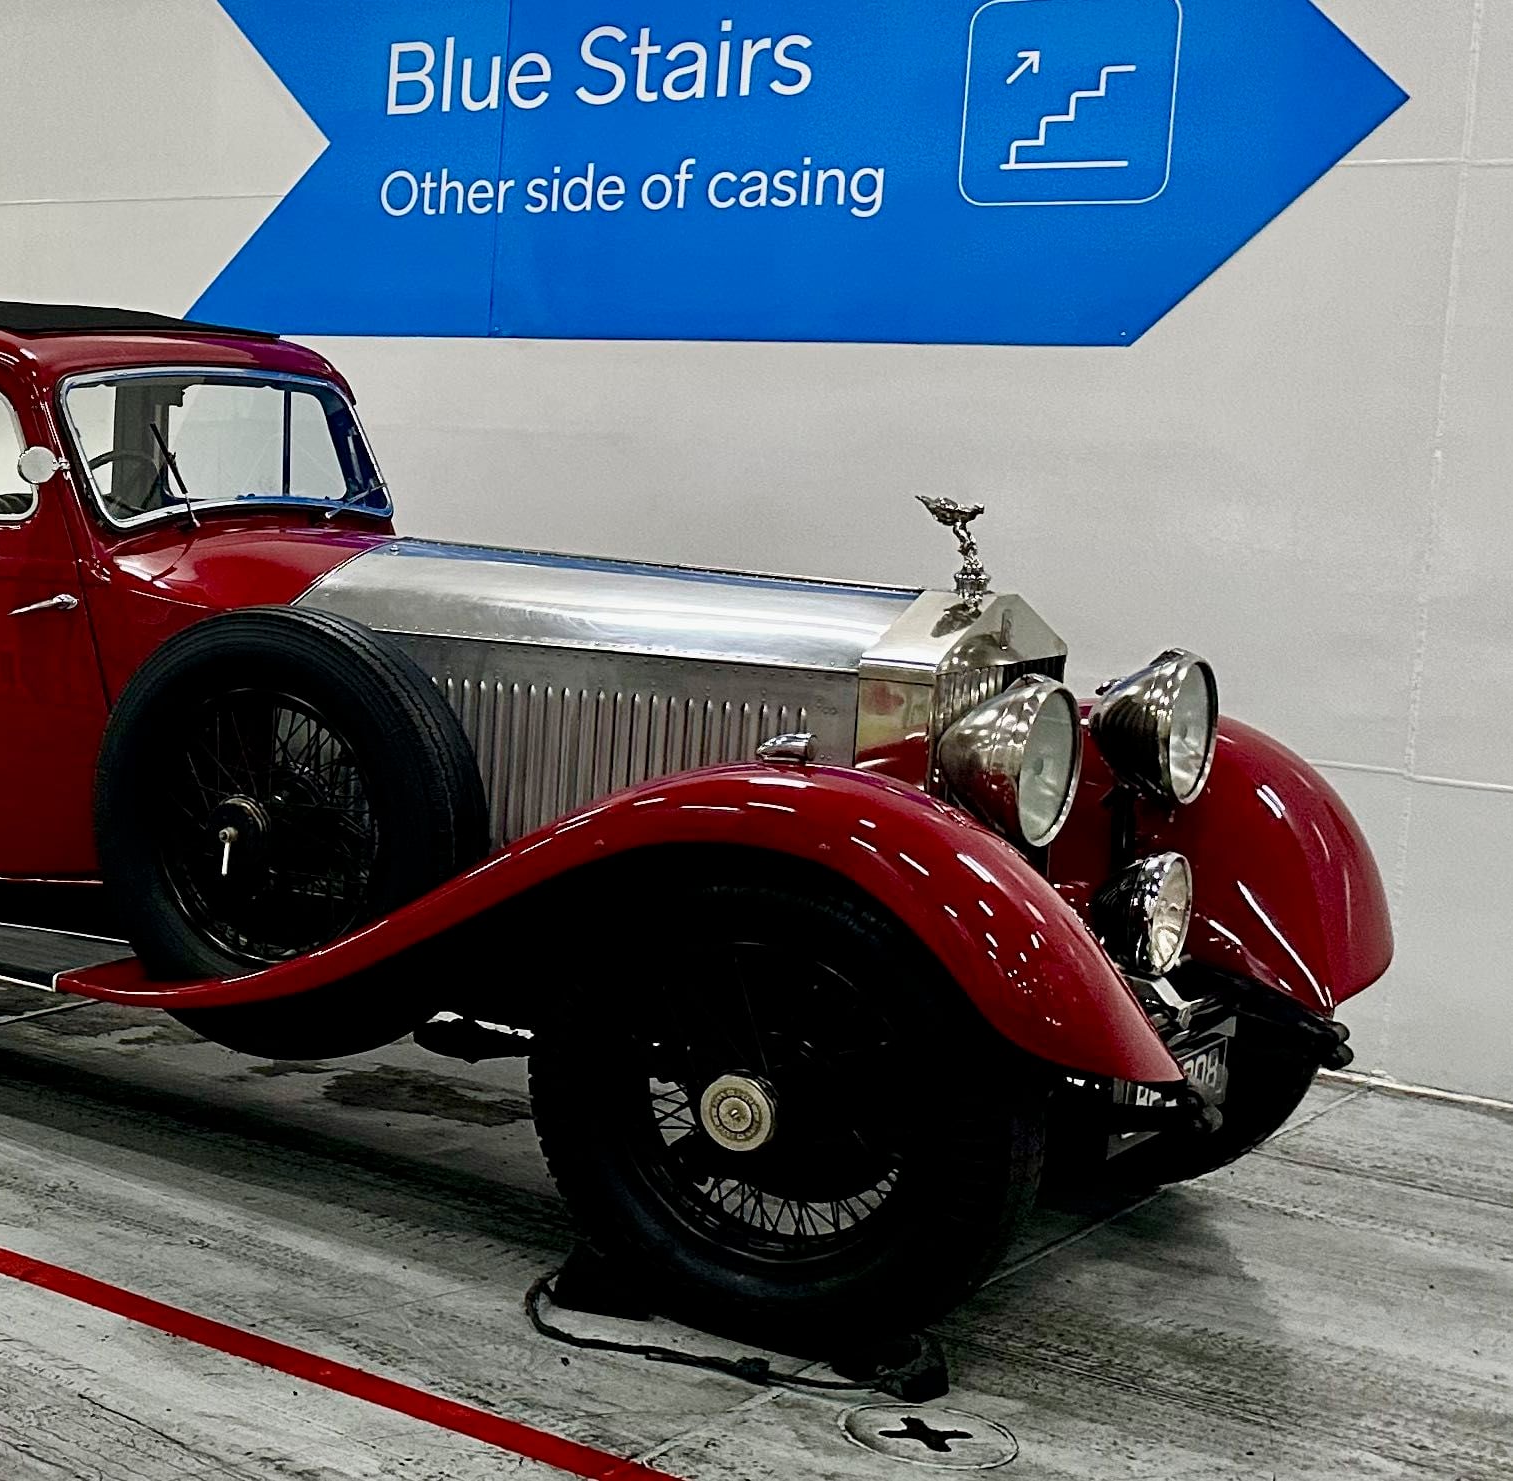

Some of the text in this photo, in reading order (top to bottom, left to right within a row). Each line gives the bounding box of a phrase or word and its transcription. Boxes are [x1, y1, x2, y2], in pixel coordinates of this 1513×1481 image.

[387, 19, 812, 115] Blue Stairs
[380, 157, 885, 218] Other side of casing
